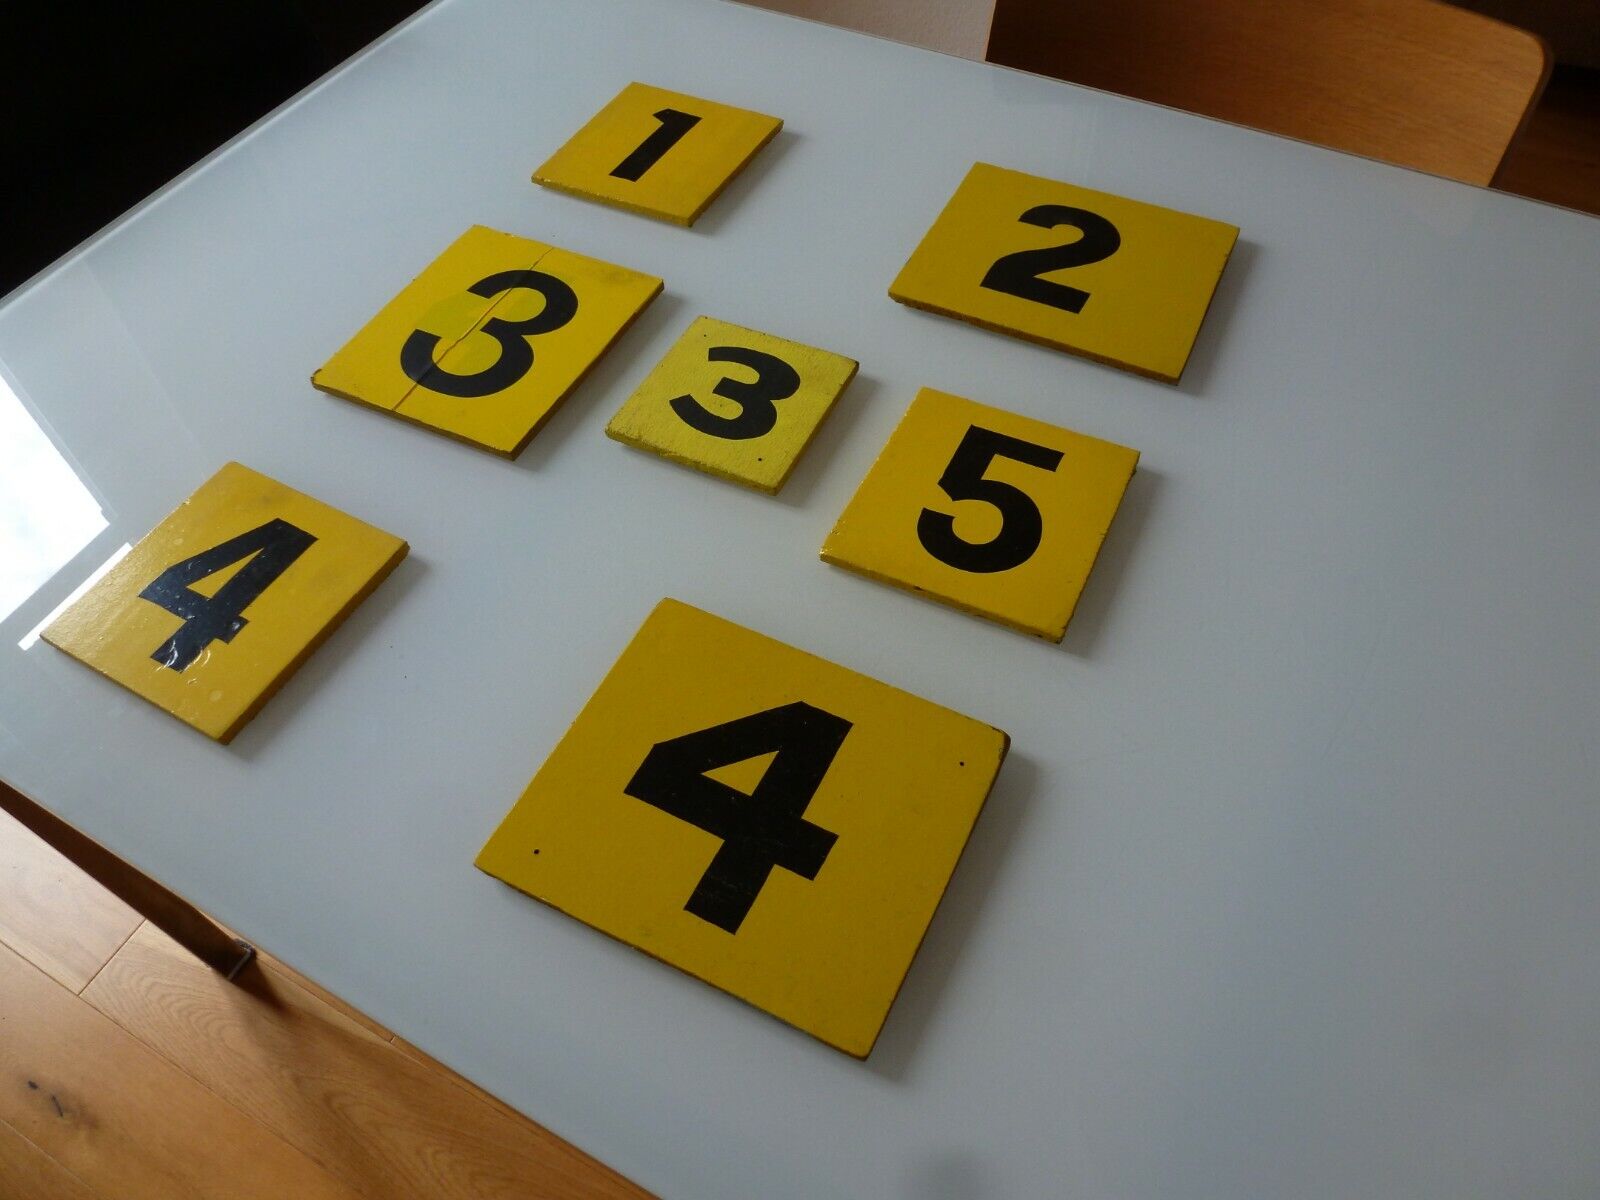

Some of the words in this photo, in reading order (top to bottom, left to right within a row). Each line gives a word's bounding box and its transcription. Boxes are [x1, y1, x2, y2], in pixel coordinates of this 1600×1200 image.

[609, 108, 702, 183] 1
[980, 204, 1122, 315] 2
[400, 269, 578, 398] 3
[669, 346, 801, 441] 3
[916, 424, 1065, 574] 5
[137, 517, 318, 673] 4
[623, 700, 853, 935] 4
